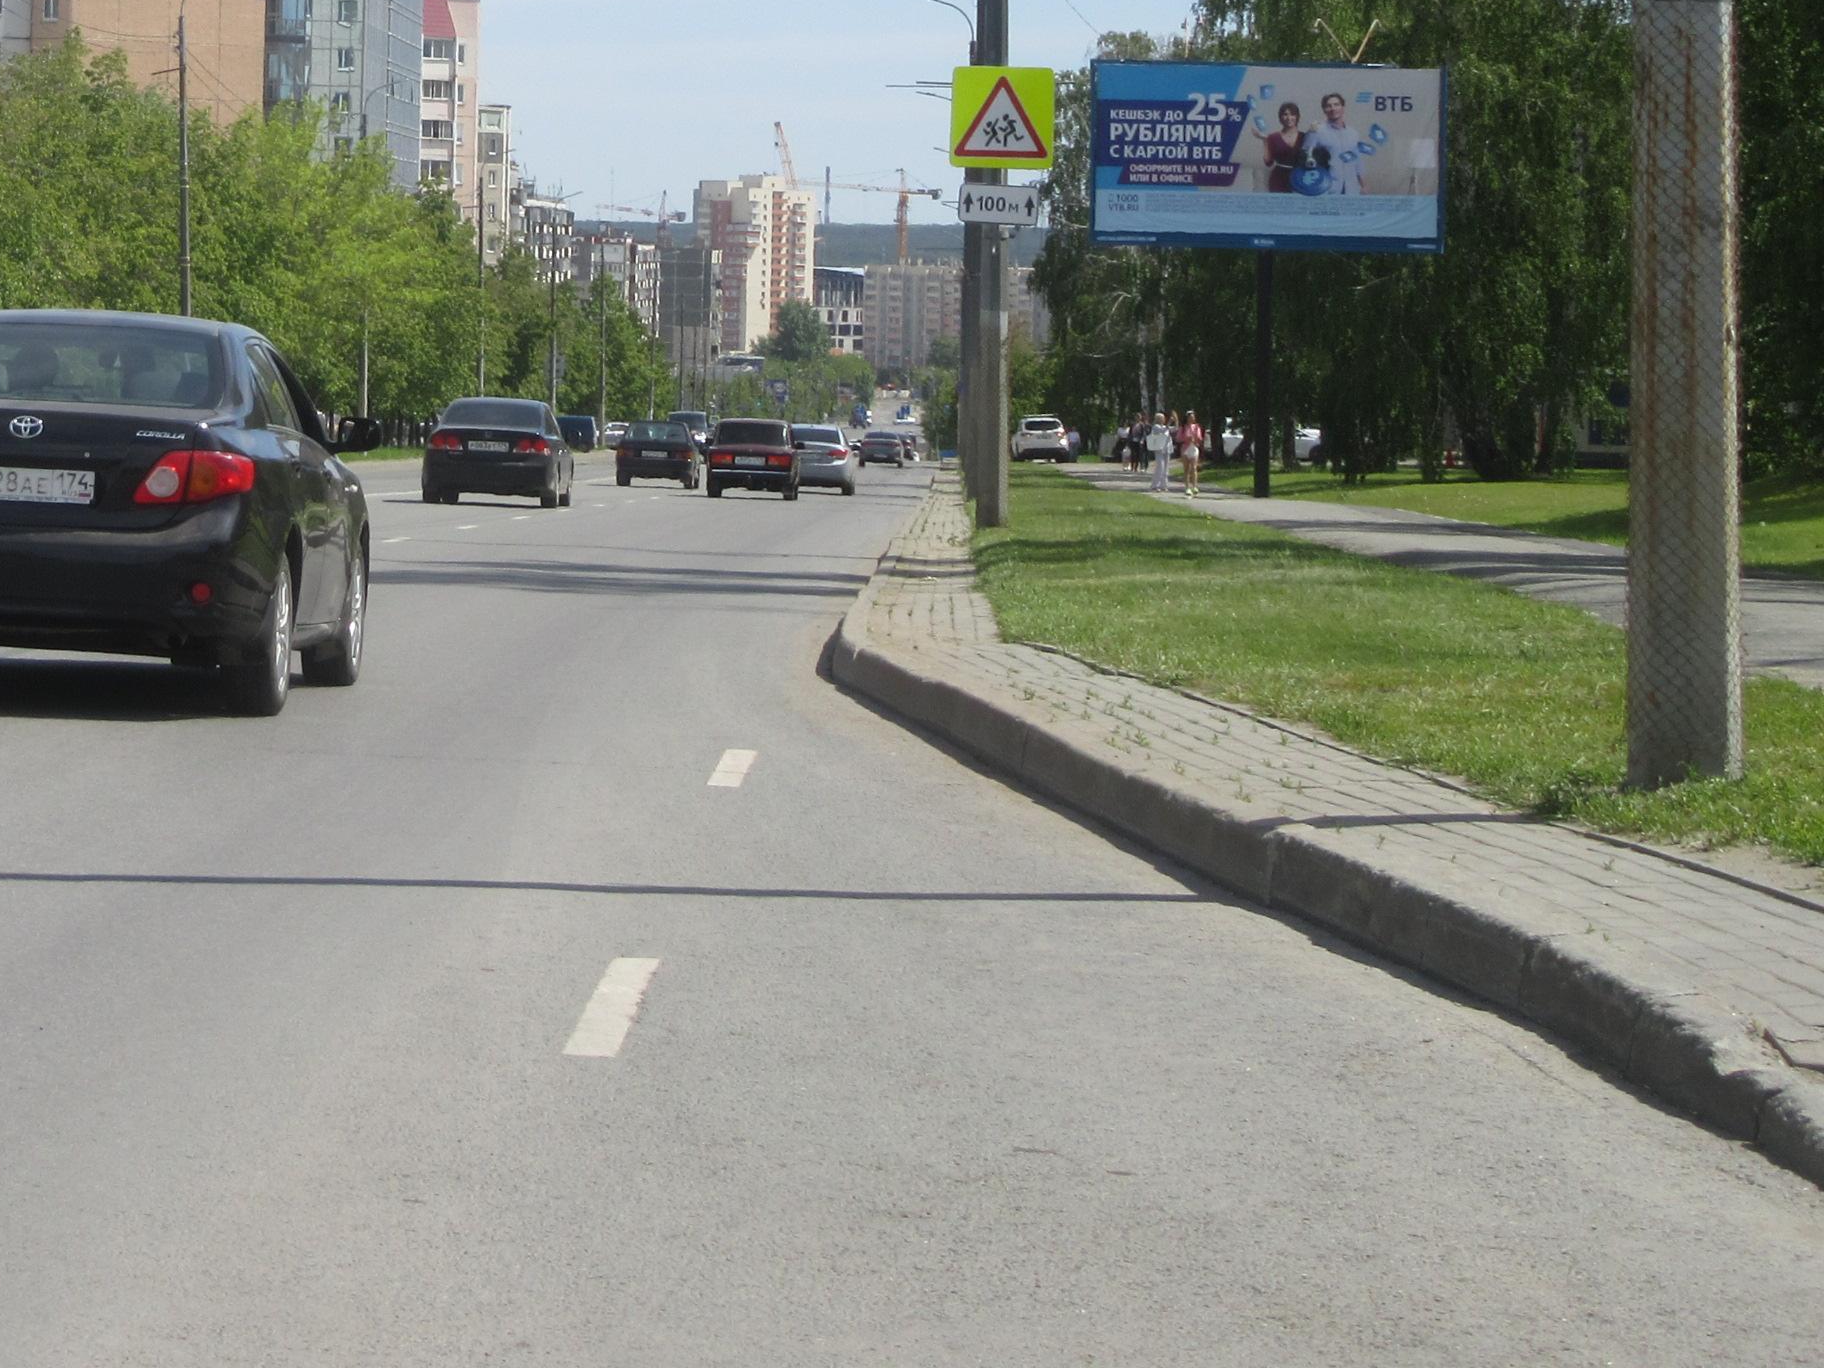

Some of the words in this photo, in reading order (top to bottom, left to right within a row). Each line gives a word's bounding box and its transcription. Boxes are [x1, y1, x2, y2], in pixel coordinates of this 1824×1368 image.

[1375, 95, 1414, 113] ВТБ
[1109, 109, 1162, 121] КЕШБЭК
[1164, 110, 1184, 123] ДО
[1109, 122, 1223, 143] РУБЛЯМИ
[1109, 144, 1120, 158] С
[1123, 143, 1189, 159] КАРТОЙ
[1192, 146, 1222, 160] ВТБ
[1129, 163, 1183, 173] ОФОРМИТЕ
[1184, 164, 1198, 173] НА
[1199, 165, 1234, 175] VTB.RU
[1129, 173, 1150, 183] ИЛИ
[1151, 174, 1158, 183] В
[1160, 174, 1193, 184] ОФИСЕ
[977, 196, 1006, 212] 100
[56, 472, 89, 492] 174
